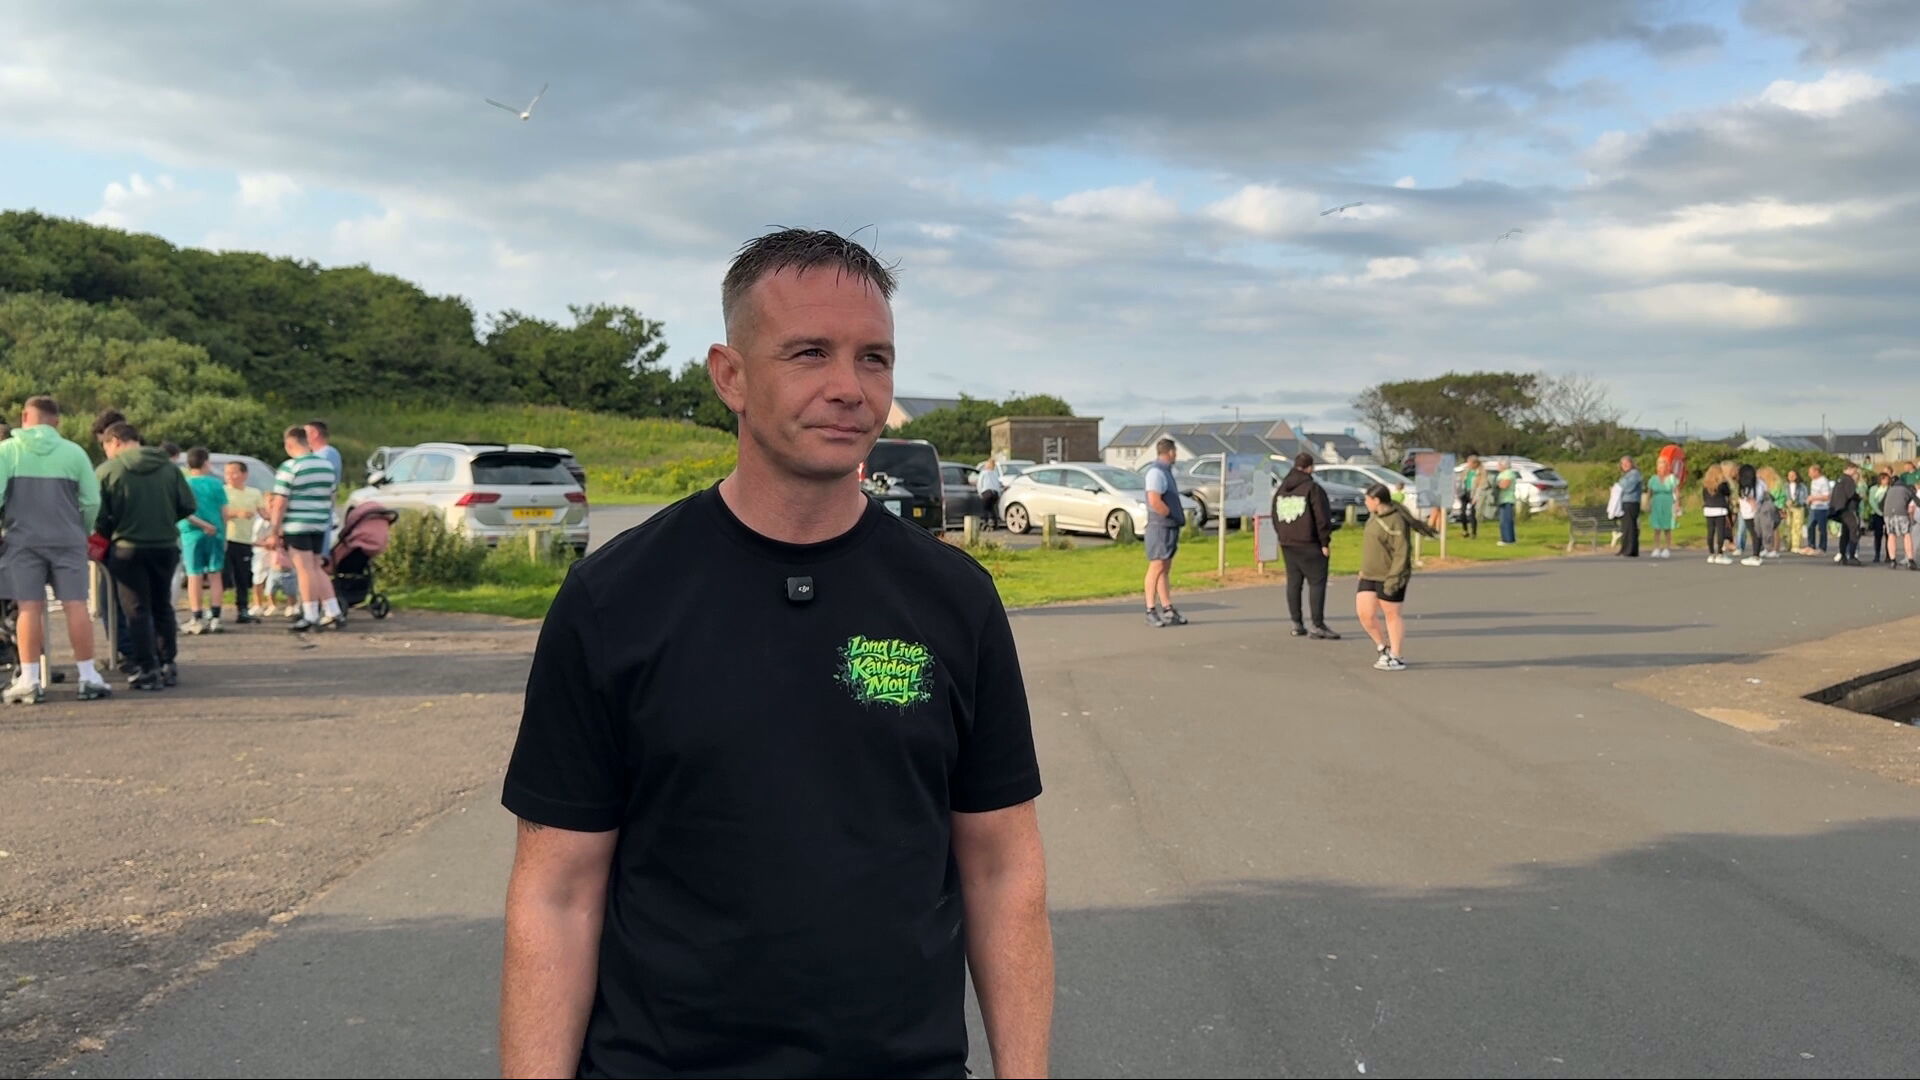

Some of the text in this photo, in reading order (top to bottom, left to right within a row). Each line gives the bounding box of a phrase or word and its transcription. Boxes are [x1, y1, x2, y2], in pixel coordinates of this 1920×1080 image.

[850, 635, 928, 662] Long Live
[851, 657, 922, 682] Kayden
[864, 676, 910, 704] Moy
